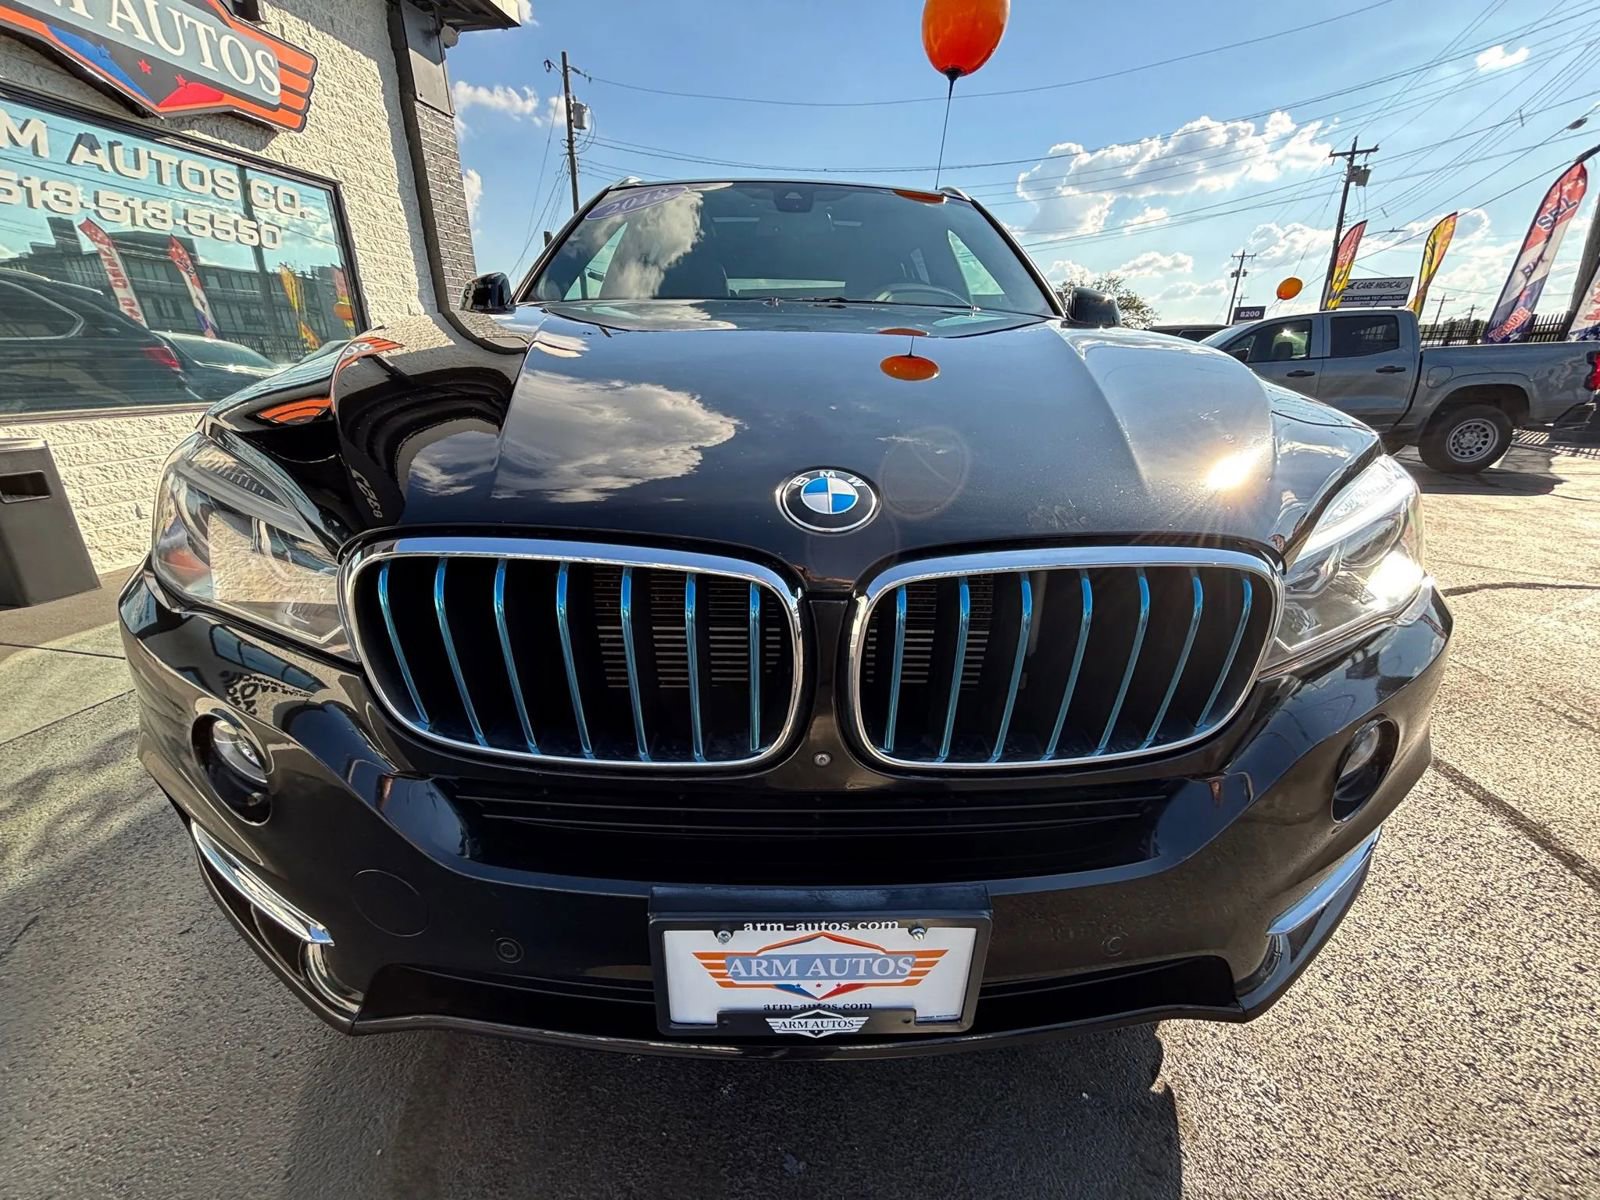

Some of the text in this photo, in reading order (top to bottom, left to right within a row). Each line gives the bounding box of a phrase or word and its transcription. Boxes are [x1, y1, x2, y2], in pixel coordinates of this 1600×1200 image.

[107, 0, 281, 97] AUTOS
[66, 132, 239, 202] AUTOS
[0, 169, 283, 250] 513-513-5550
[604, 188, 669, 215] 2018
[1374, 280, 1402, 289] MEDICAL
[1240, 310, 1260, 318] 8200
[1488, 306, 1532, 342] TRADE
[791, 471, 865, 487] BMW
[743, 919, 899, 932] arm-autos.com
[727, 955, 914, 977] ARM AUTOS
[763, 1002, 873, 1011] arm-autos.com
[778, 1019, 855, 1029] ARM AUTOS
